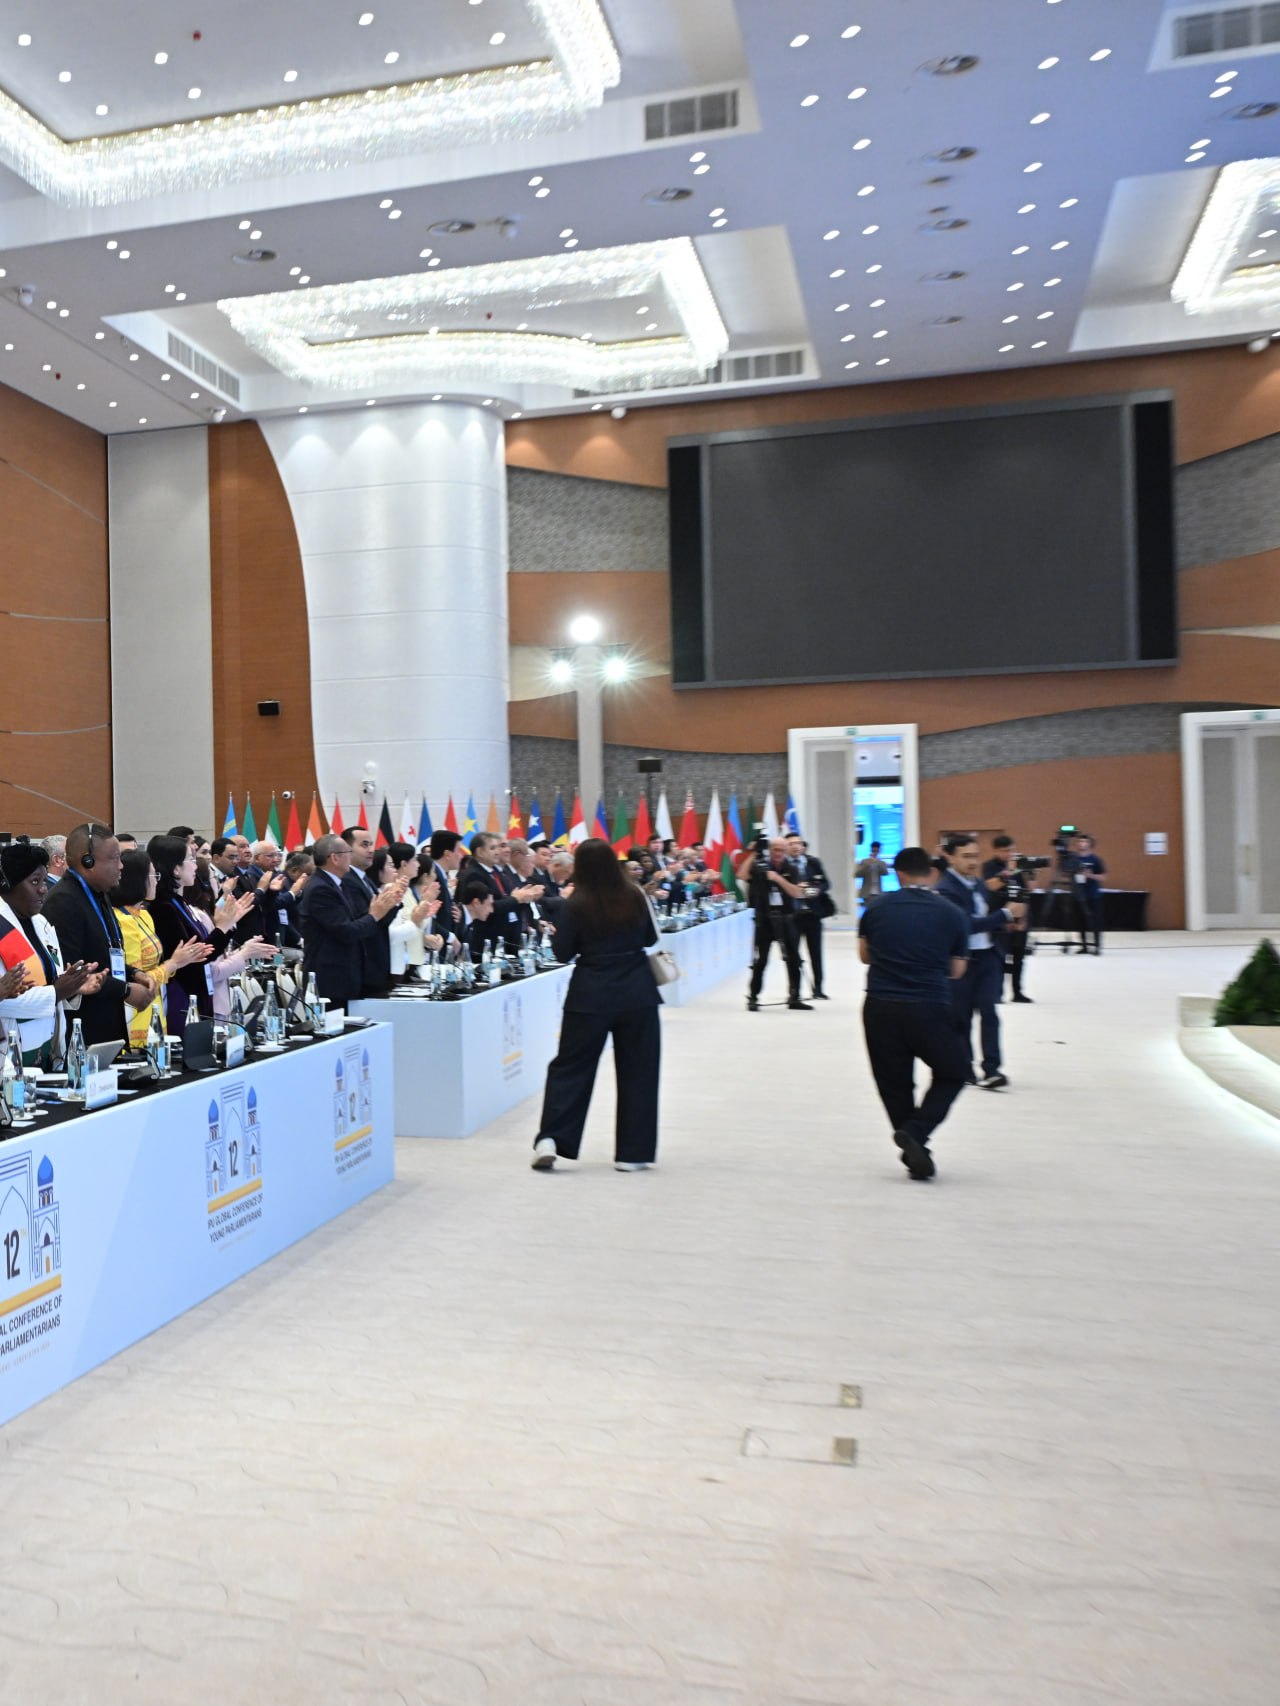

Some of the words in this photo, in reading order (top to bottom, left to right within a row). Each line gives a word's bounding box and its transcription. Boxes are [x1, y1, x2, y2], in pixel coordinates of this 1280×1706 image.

[4, 1230, 20, 1280] 12
[8, 1300, 53, 1333] CONFERENCE
[53, 1294, 63, 1310] OF
